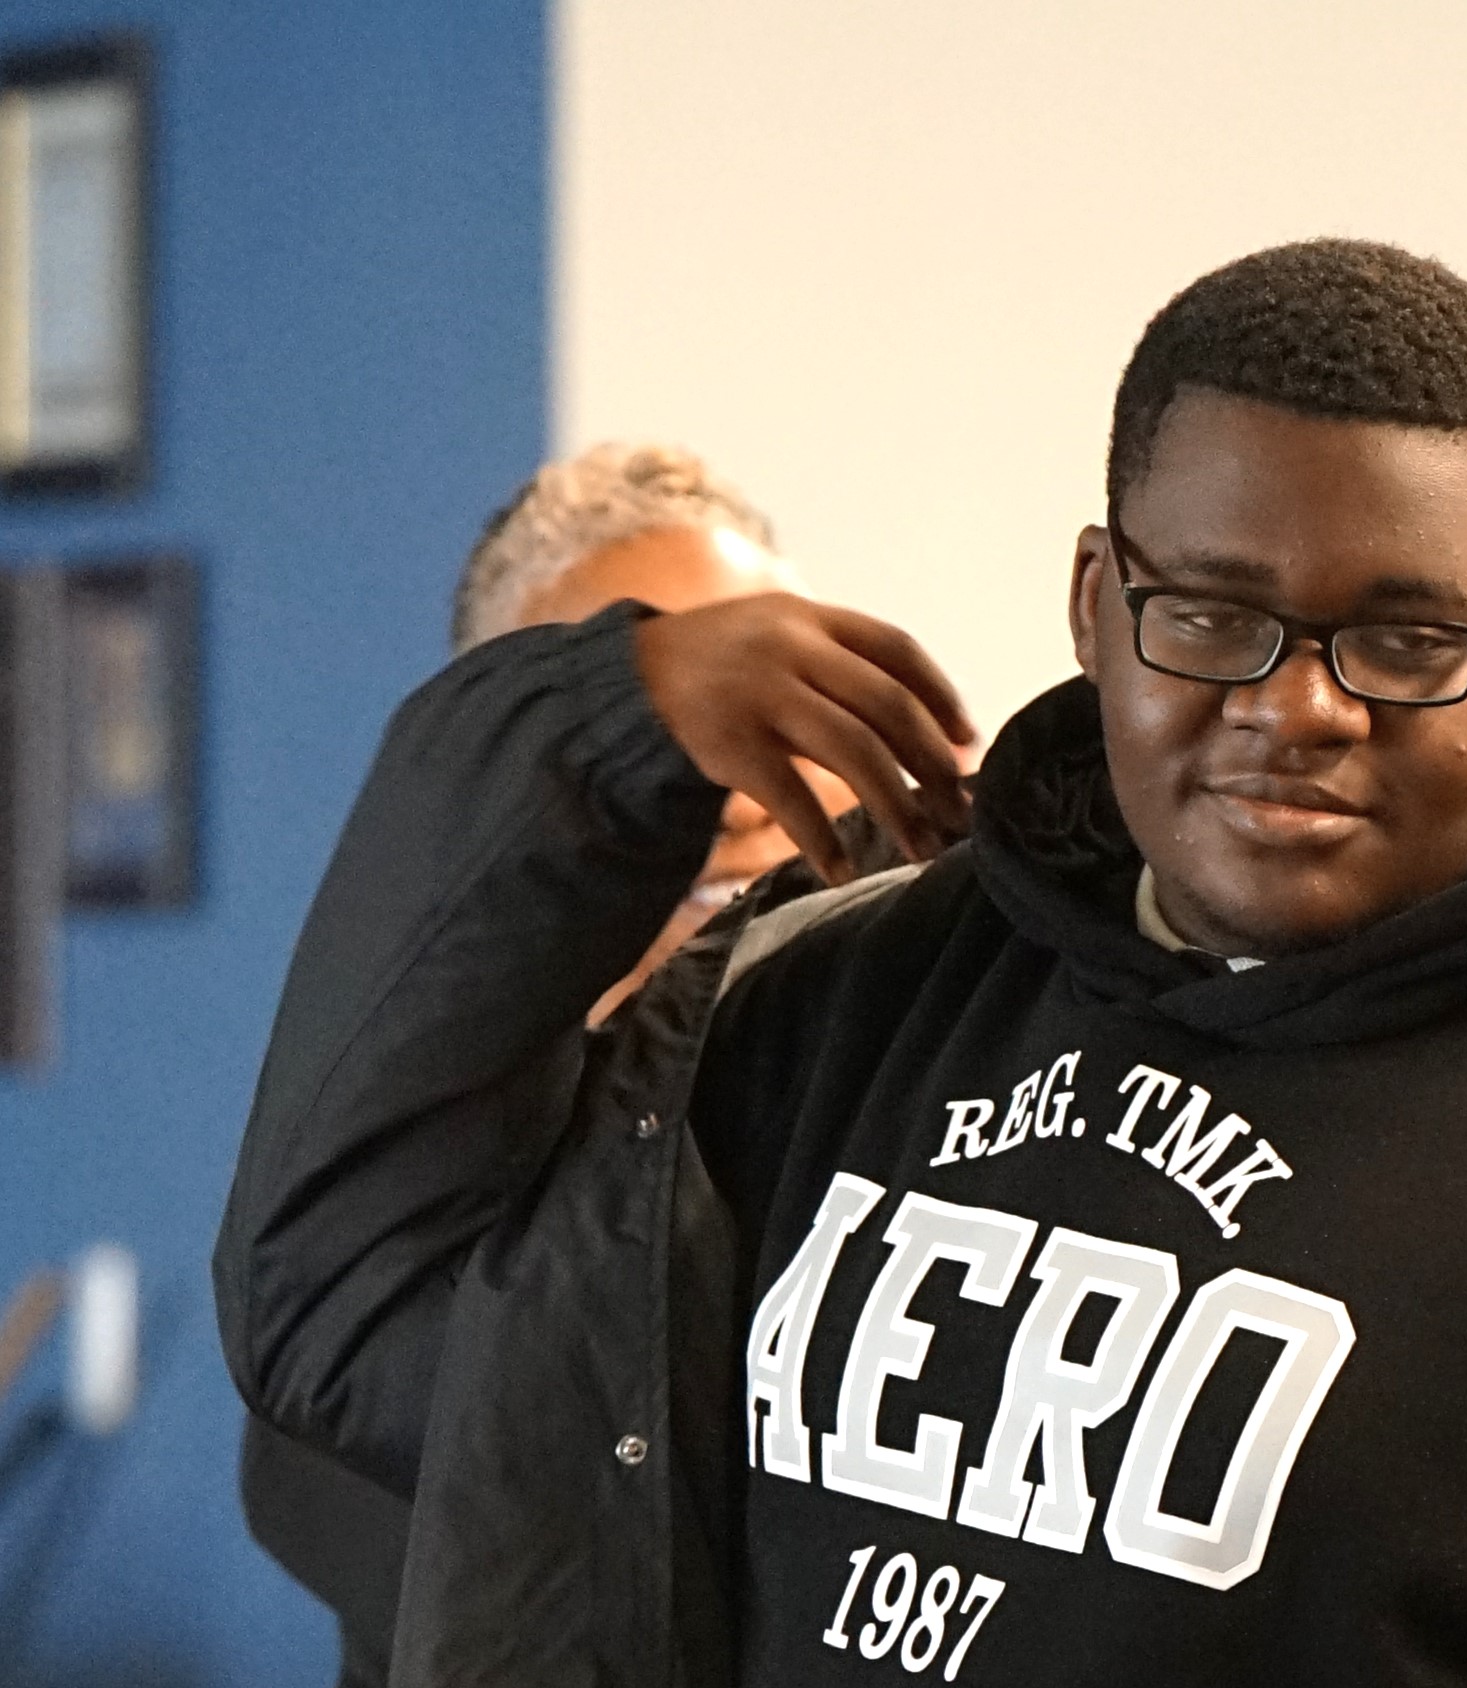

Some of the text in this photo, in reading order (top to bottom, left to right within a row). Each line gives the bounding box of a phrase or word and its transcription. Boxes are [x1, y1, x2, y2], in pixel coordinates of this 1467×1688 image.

[929, 1051, 1292, 1239] REG. TMK.
[746, 1171, 1357, 1591] AERO
[822, 1546, 1006, 1682] 1987
